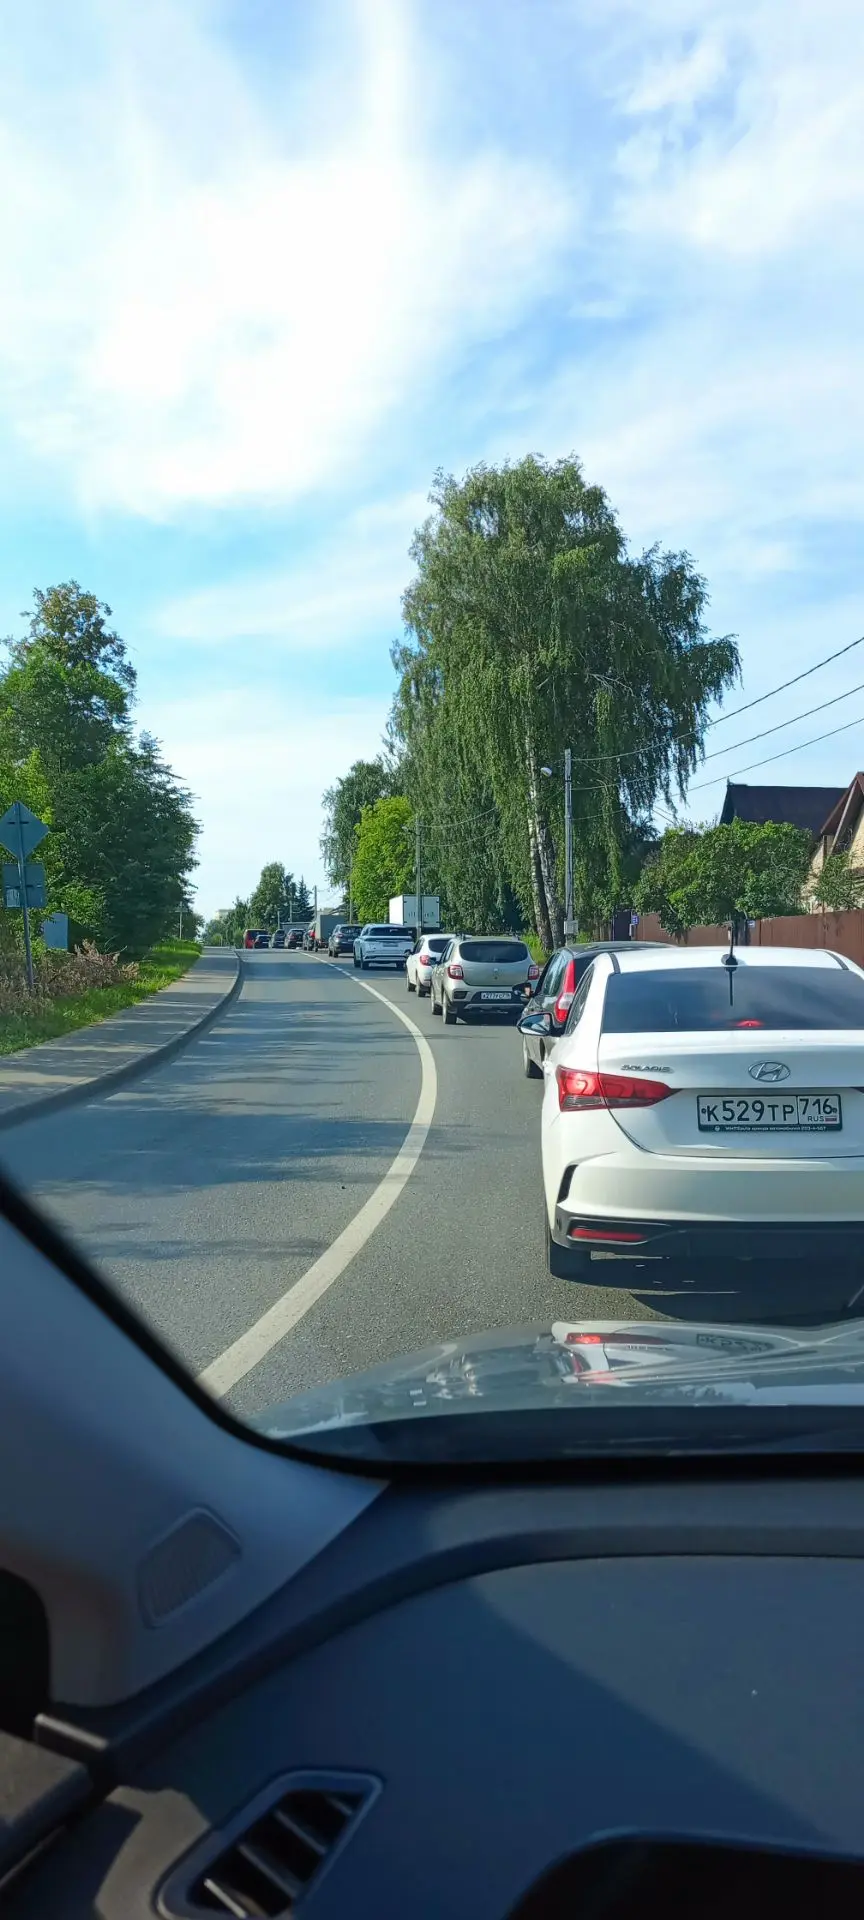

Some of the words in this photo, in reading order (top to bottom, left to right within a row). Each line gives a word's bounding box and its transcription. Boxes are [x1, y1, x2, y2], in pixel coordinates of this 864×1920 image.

[620, 1064, 671, 1074] SOLARIS
[706, 1100, 795, 1122] К529ТР
[799, 1098, 833, 1115] 716
